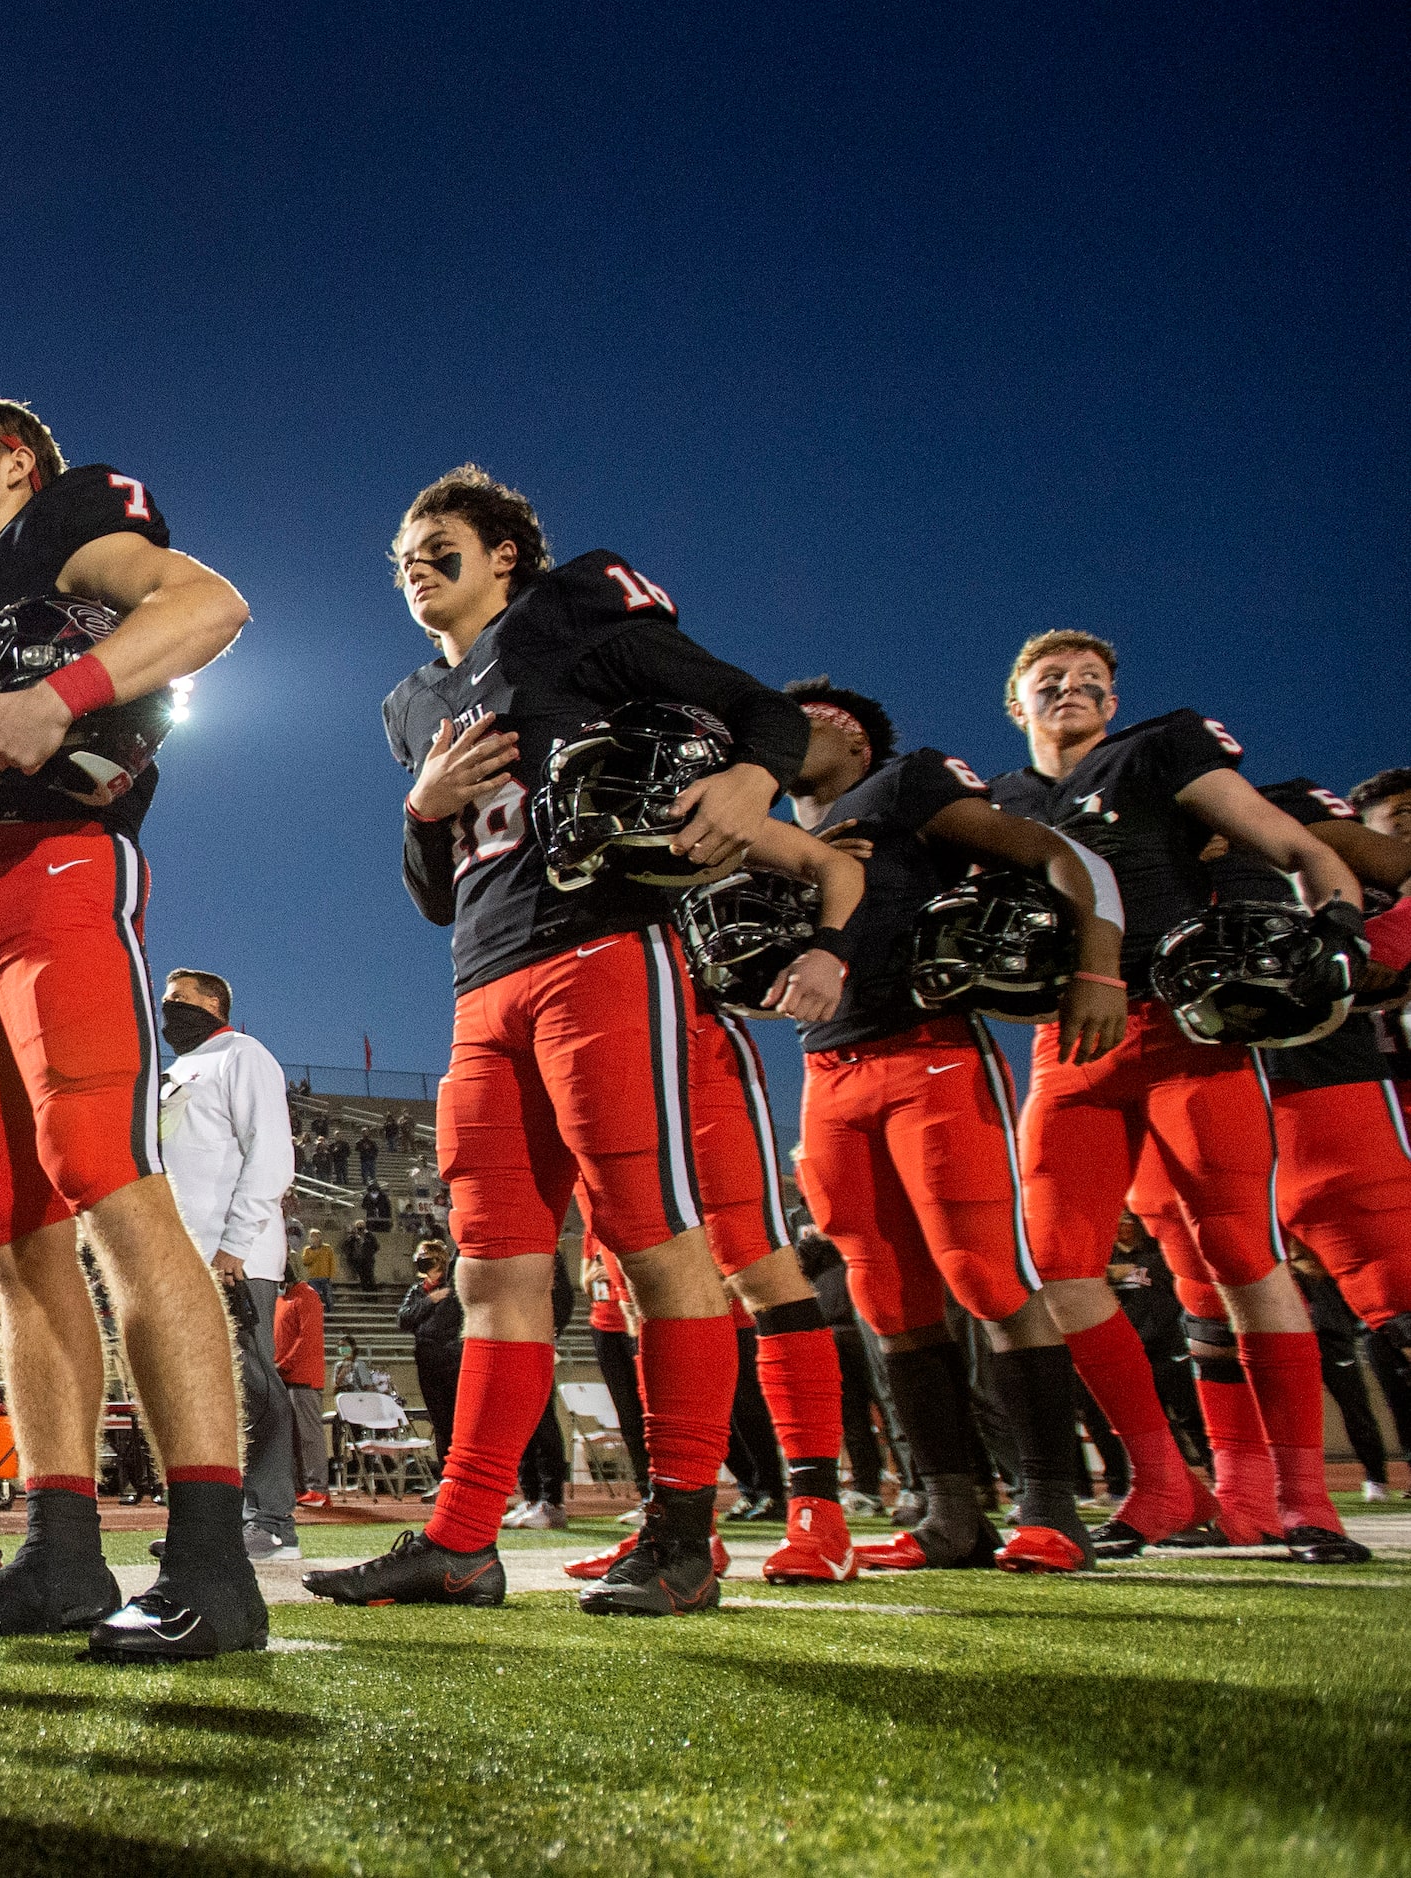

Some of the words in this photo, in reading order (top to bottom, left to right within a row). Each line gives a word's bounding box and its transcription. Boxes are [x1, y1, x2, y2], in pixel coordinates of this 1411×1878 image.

[107, 472, 152, 522] 7
[1202, 718, 1244, 756] 5
[943, 756, 989, 790] 6
[1308, 788, 1357, 818] 5
